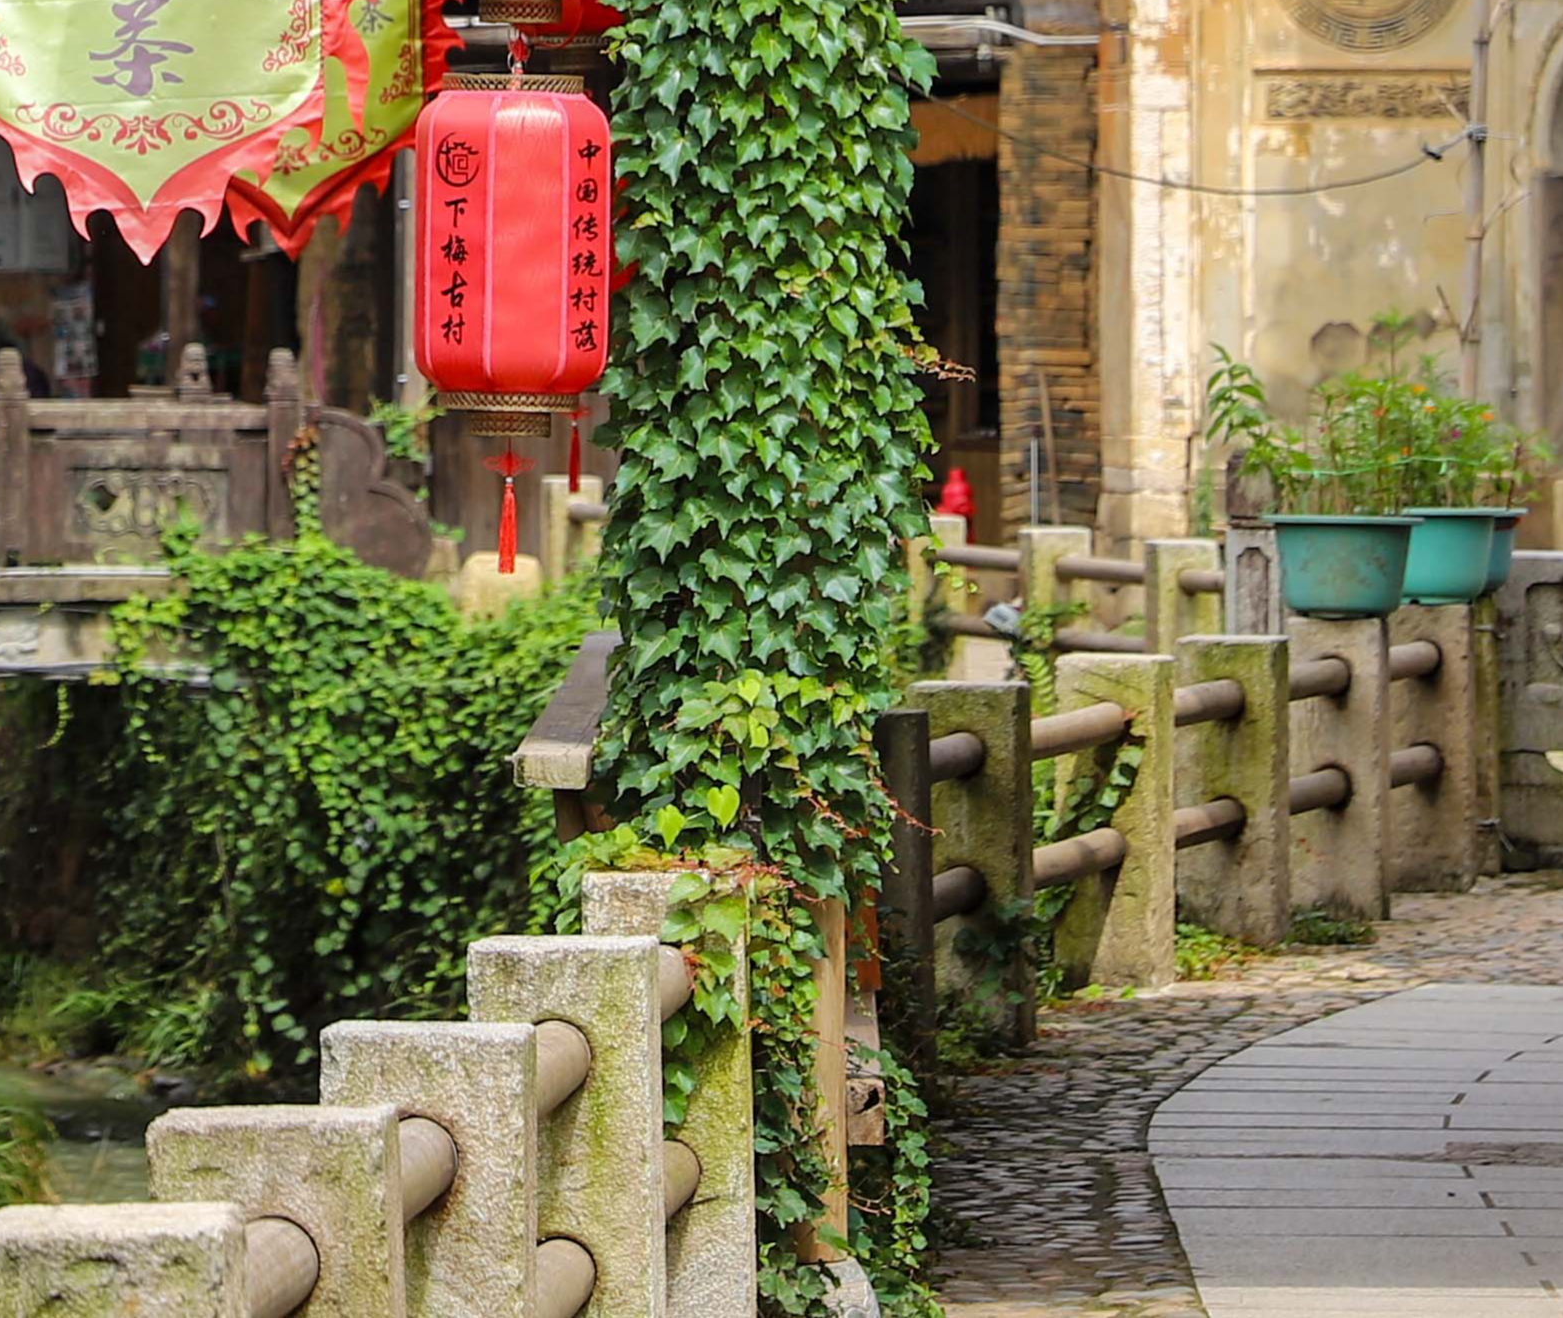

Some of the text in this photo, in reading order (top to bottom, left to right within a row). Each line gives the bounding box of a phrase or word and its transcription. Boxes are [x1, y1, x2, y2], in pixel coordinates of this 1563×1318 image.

[440, 197, 470, 346] 下梅古村
[569, 138, 603, 353] 中国传统村落
